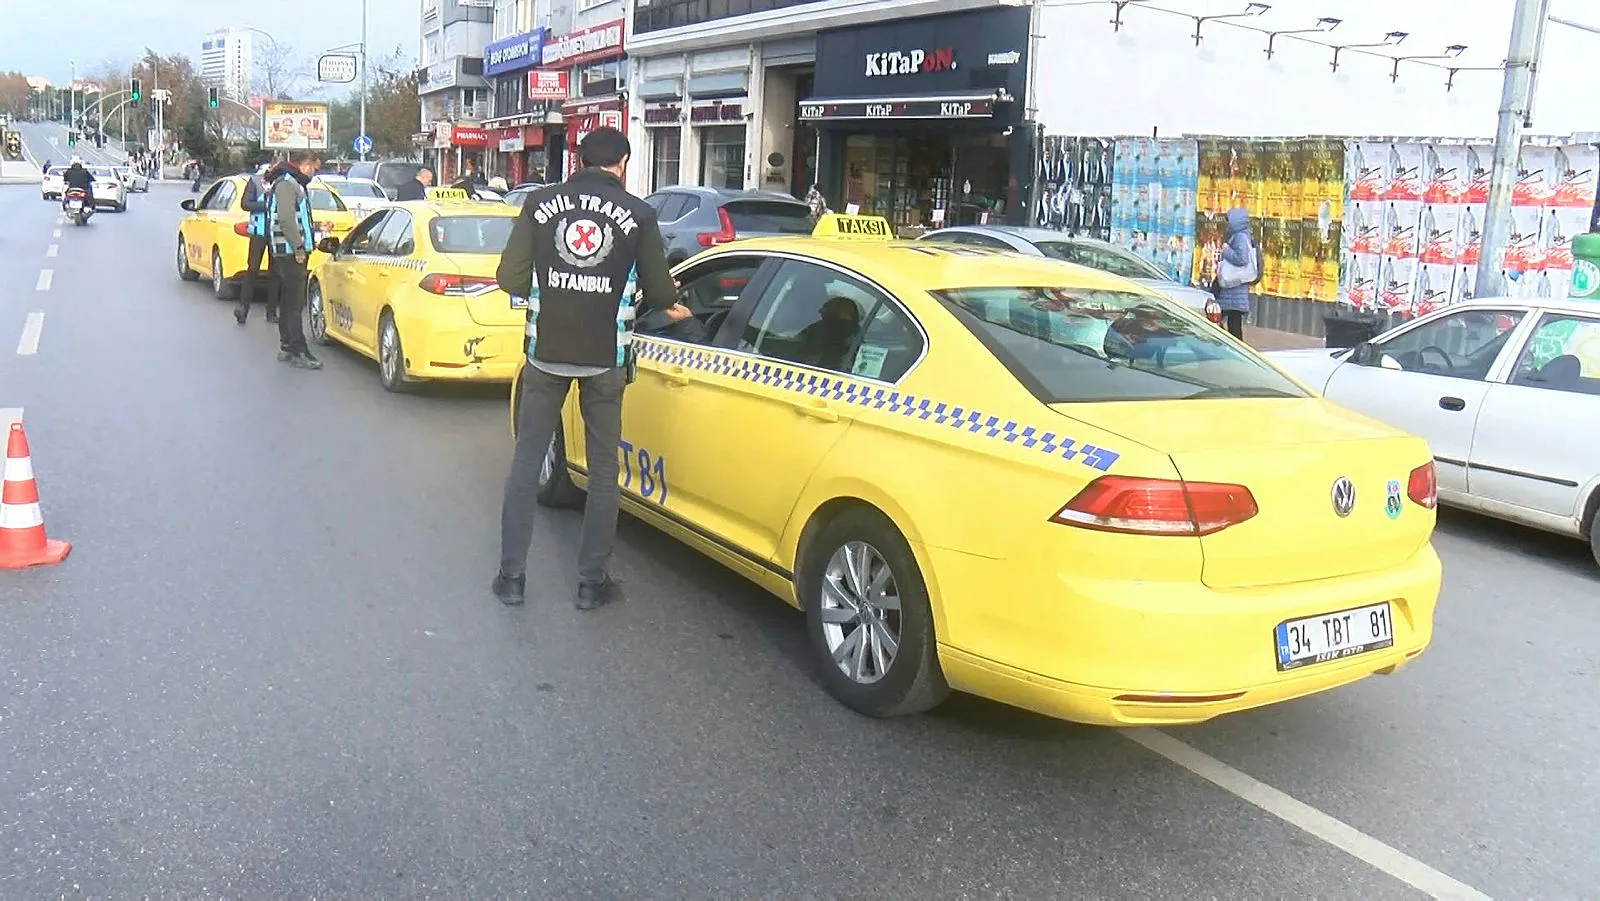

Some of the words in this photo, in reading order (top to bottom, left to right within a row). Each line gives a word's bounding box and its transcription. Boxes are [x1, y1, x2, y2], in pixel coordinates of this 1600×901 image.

[456, 131, 488, 140] PHARMACY
[548, 267, 613, 294] İSTANBUL
[1290, 624, 1311, 654] 34
[1322, 616, 1351, 648] TBT
[1370, 608, 1387, 638] 81
